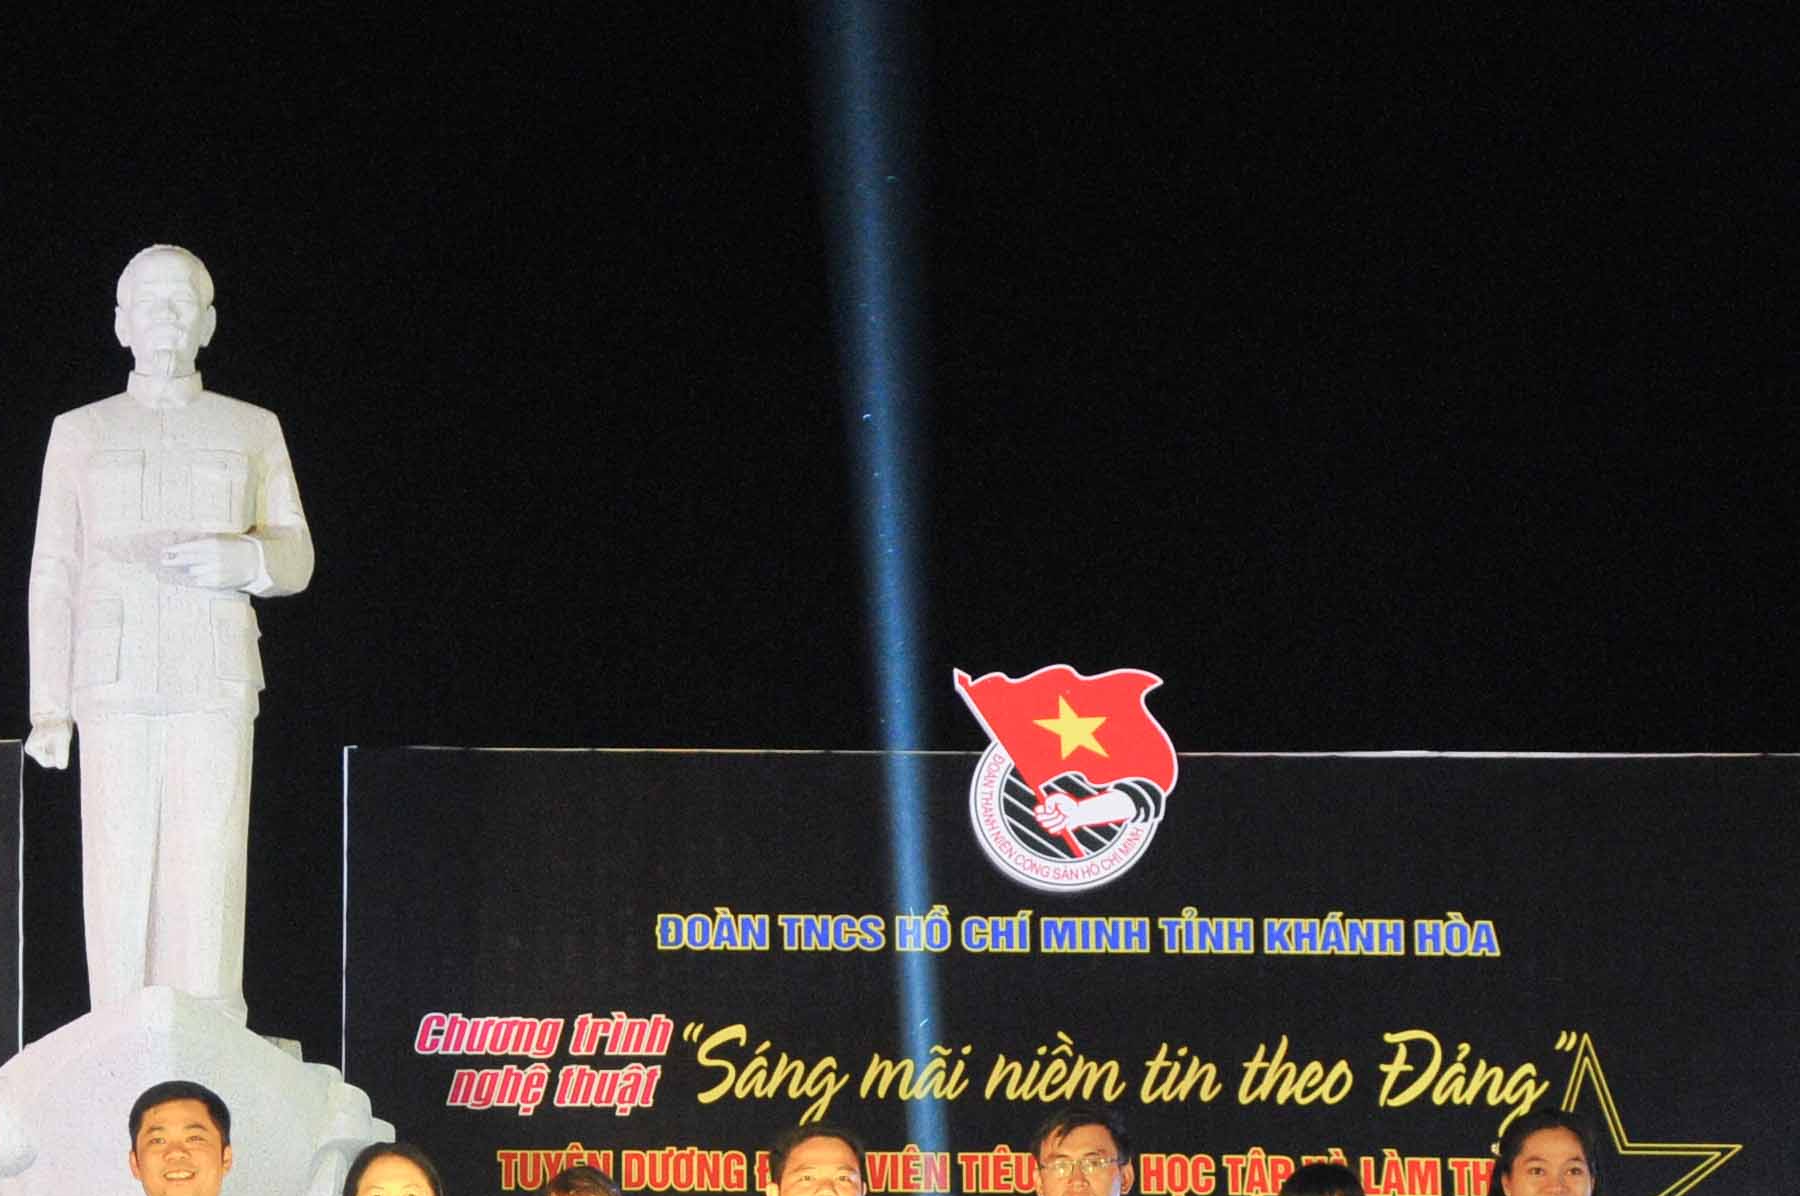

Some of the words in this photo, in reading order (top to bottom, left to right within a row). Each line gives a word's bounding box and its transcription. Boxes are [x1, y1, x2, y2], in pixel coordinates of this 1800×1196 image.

[655, 907, 771, 952] ĐOÀN
[778, 914, 886, 952] TNCS
[895, 905, 951, 952] HỒ
[961, 909, 1031, 953] CHÍ
[1040, 917, 1150, 954] MINH
[1158, 905, 1253, 955] TỈNH
[1263, 911, 1404, 956] KHÁNH
[1415, 911, 1501, 957] HÒA
[415, 1012, 564, 1058] Chương
[568, 1011, 674, 1056] trình
[447, 1062, 551, 1116] nghệ
[553, 1062, 662, 1116] thuật
[860, 1043, 972, 1100] mãi
[984, 1030, 1126, 1103] niềm
[1140, 1041, 1222, 1104] tin
[1238, 1034, 1353, 1106] theo
[621, 1146, 747, 1192] DƯƠNG
[865, 1143, 950, 1193] VIÊN
[958, 1144, 1037, 1193] TIÊU
